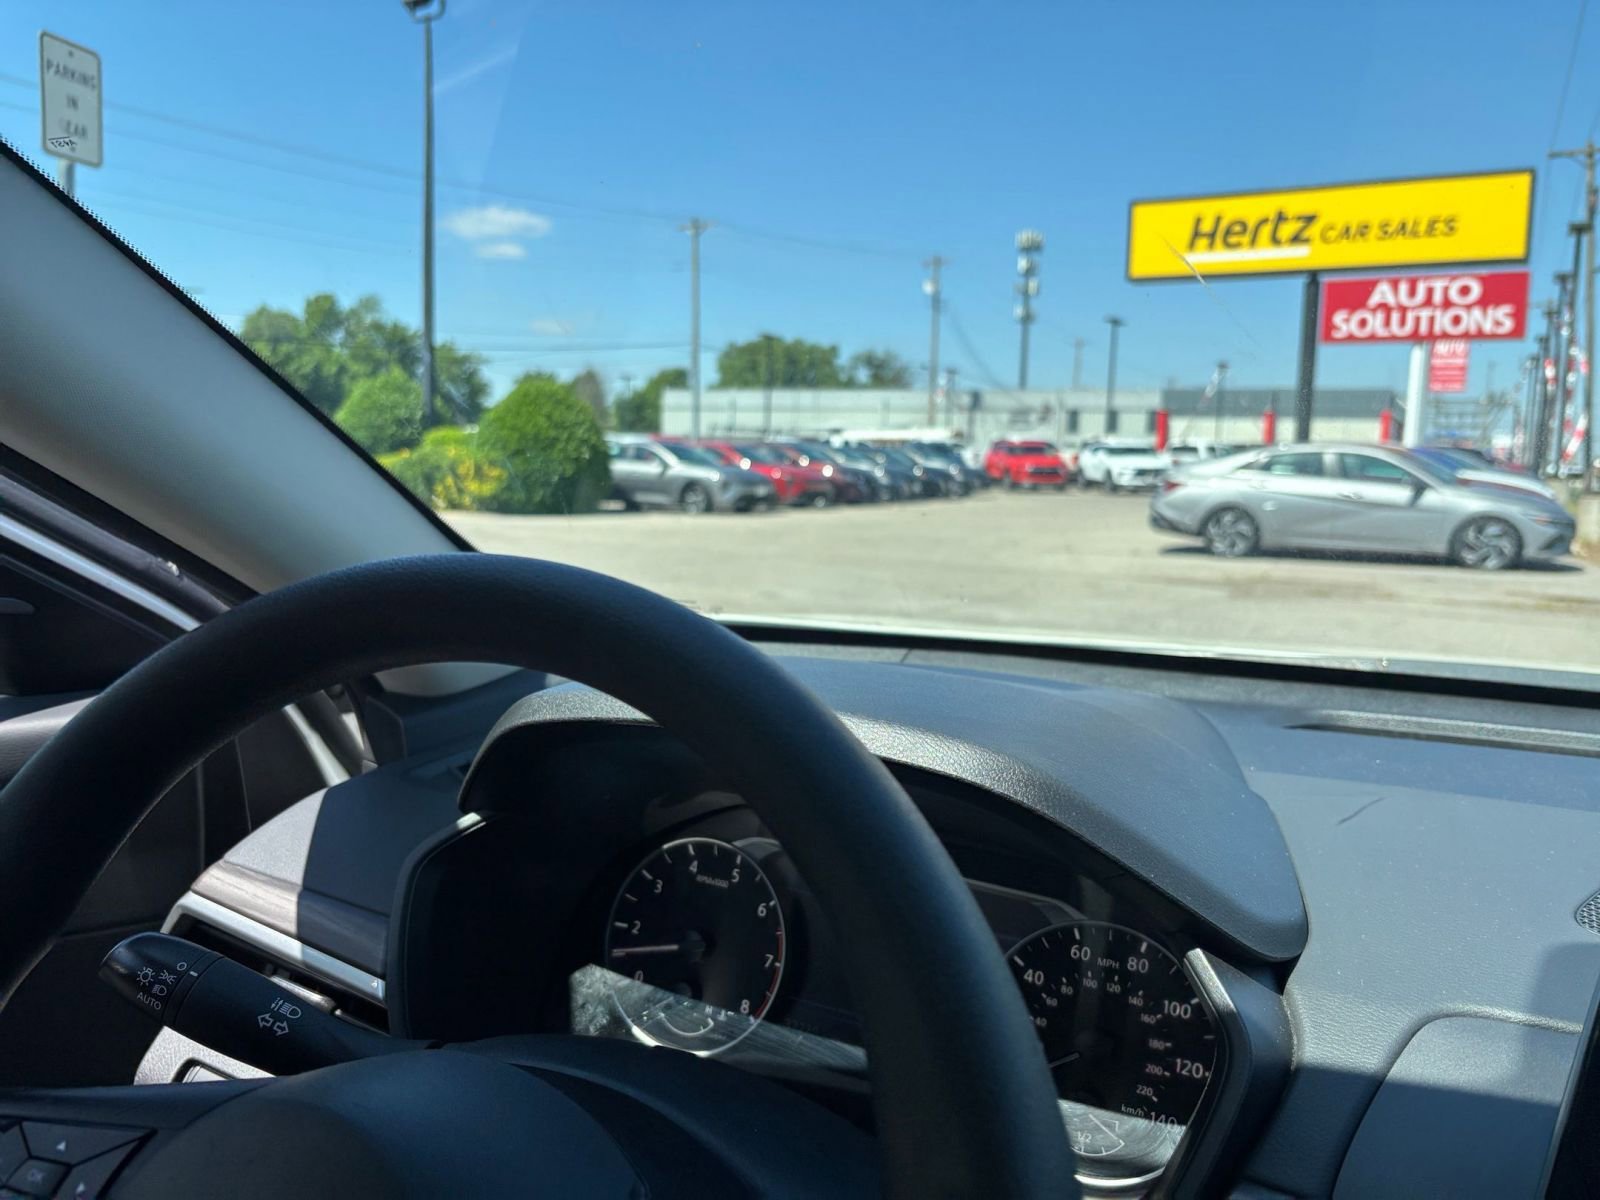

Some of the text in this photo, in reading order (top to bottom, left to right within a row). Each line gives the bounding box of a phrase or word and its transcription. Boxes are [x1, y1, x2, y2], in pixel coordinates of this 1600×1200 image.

[66, 95, 79, 110] IN
[1187, 209, 1459, 251] Hertz CAR SALES
[1366, 276, 1484, 309] AUTO
[1331, 304, 1515, 339] SOLUTIONS
[688, 860, 698, 875] 4
[731, 868, 741, 883] 5
[653, 879, 664, 894] 3
[757, 903, 768, 917] 6
[631, 920, 641, 935] 2
[1070, 945, 1092, 961] 60
[764, 954, 774, 969] 7
[1097, 957, 1120, 970] MPH
[1127, 956, 1149, 974] 80
[1023, 969, 1045, 985] 40
[1083, 977, 1098, 989] 100
[1060, 983, 1074, 996] 80
[1106, 982, 1121, 994] 120
[136, 990, 163, 1011] AUTO
[740, 999, 751, 1014] 8
[1128, 996, 1144, 1008] 140
[1163, 999, 1192, 1020] 100
[1034, 1015, 1048, 1027] 40
[1140, 1012, 1157, 1025] 160
[1145, 1063, 1164, 1076] 200
[1174, 1057, 1205, 1079] 120
[1136, 1084, 1153, 1098] 220
[1121, 1102, 1145, 1117] km/h
